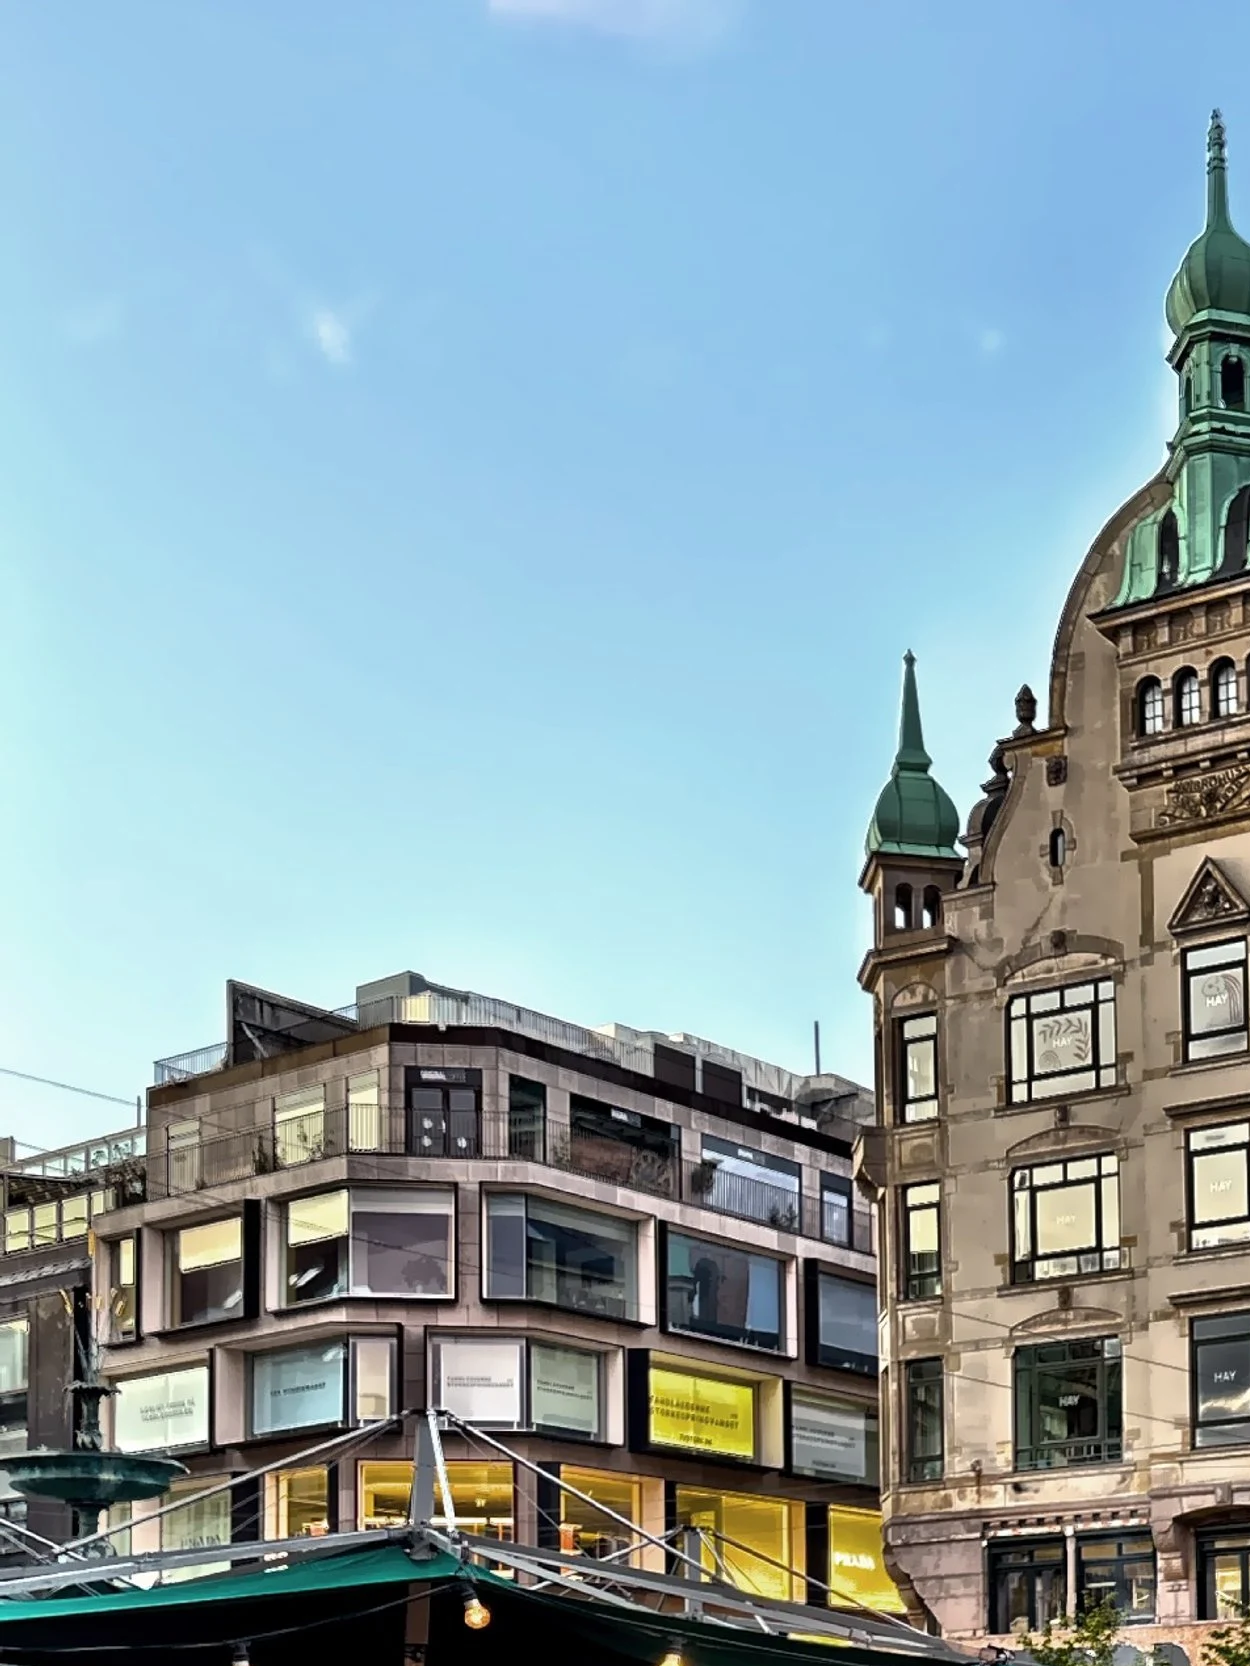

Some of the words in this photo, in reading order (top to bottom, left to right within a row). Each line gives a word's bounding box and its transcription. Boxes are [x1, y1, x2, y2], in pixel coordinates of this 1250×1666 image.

[1206, 993, 1228, 1008] HAY
[1052, 1036, 1073, 1048] HAY
[1209, 1179, 1232, 1193] HAY
[1213, 1369, 1236, 1383] HAY
[1058, 1394, 1080, 1407] HAY
